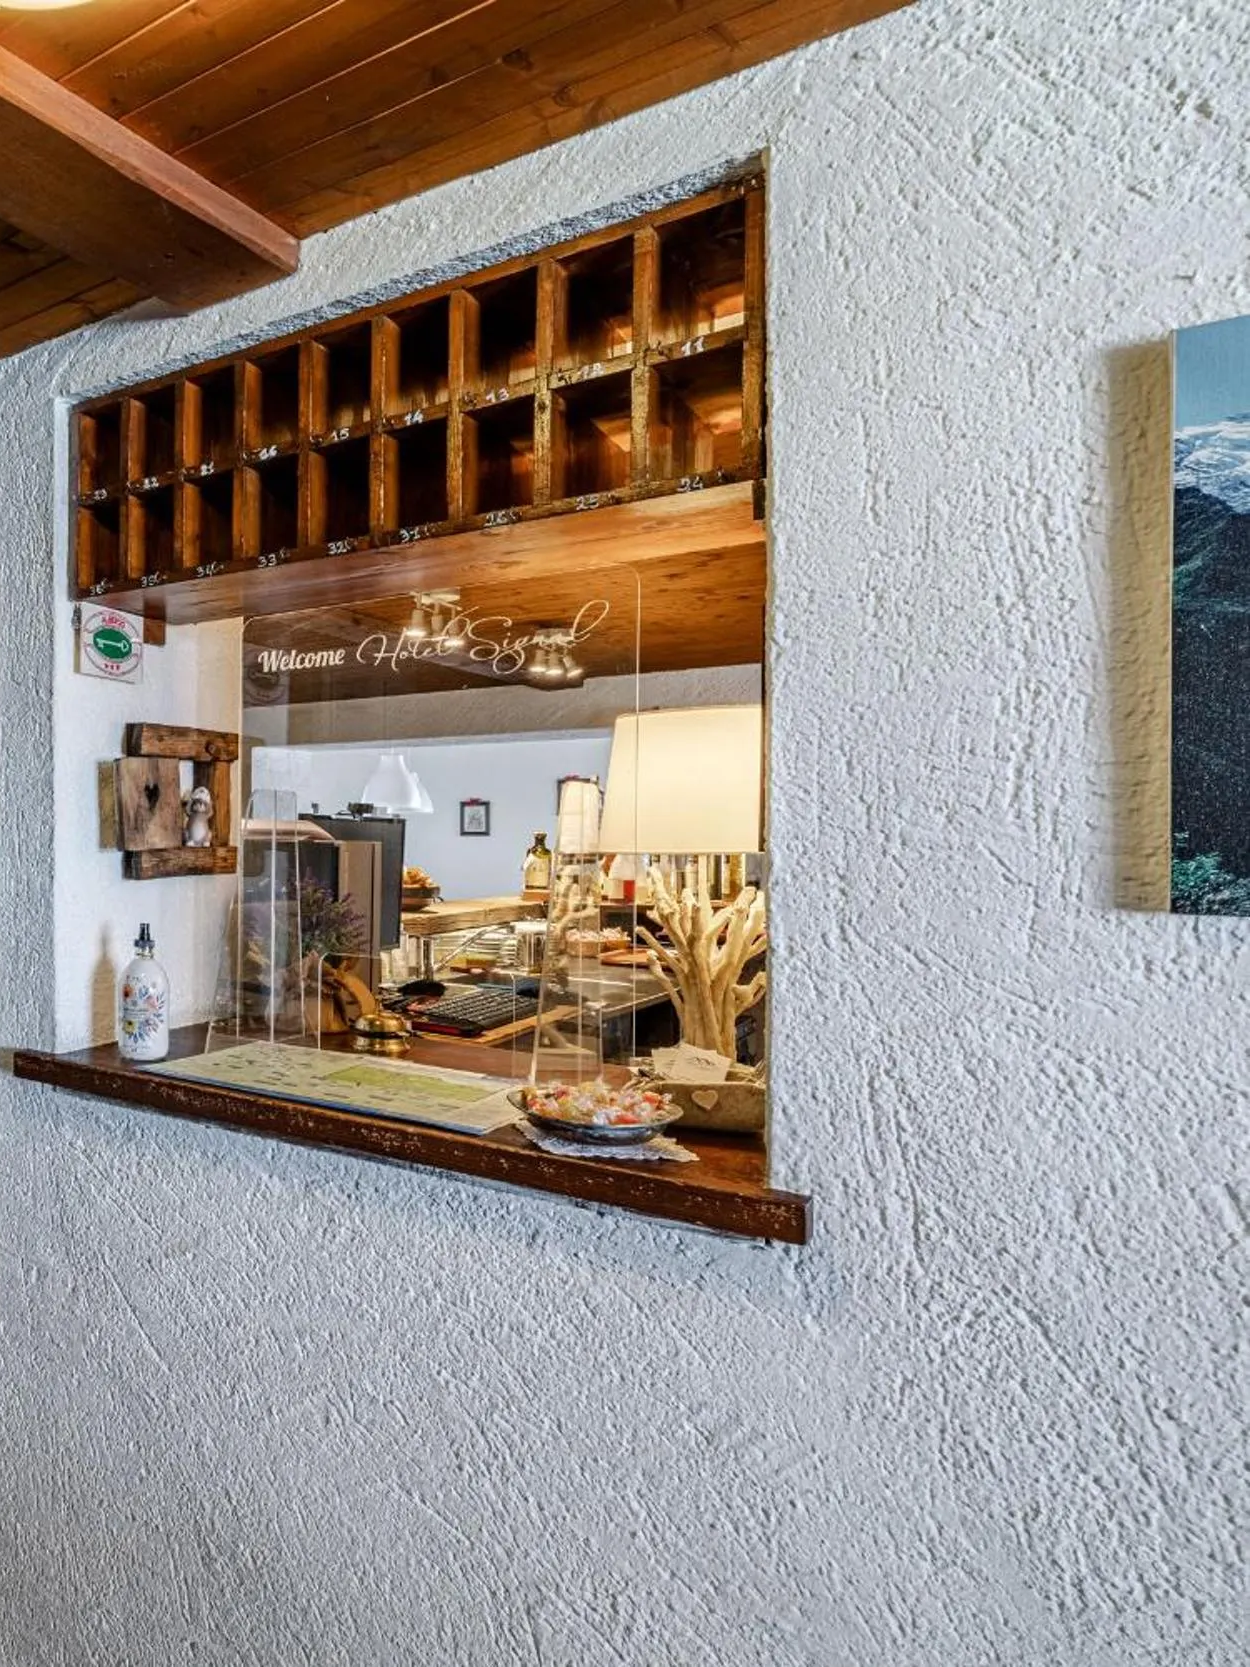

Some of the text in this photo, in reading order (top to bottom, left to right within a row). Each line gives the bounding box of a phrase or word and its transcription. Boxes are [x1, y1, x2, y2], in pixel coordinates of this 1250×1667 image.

[680, 335, 706, 356] 11
[485, 387, 510, 403] 13
[403, 408, 425, 426] 14
[330, 426, 350, 442] 15
[257, 553, 277, 568] 33
[257, 599, 610, 674] Welcome Hotel Signal
